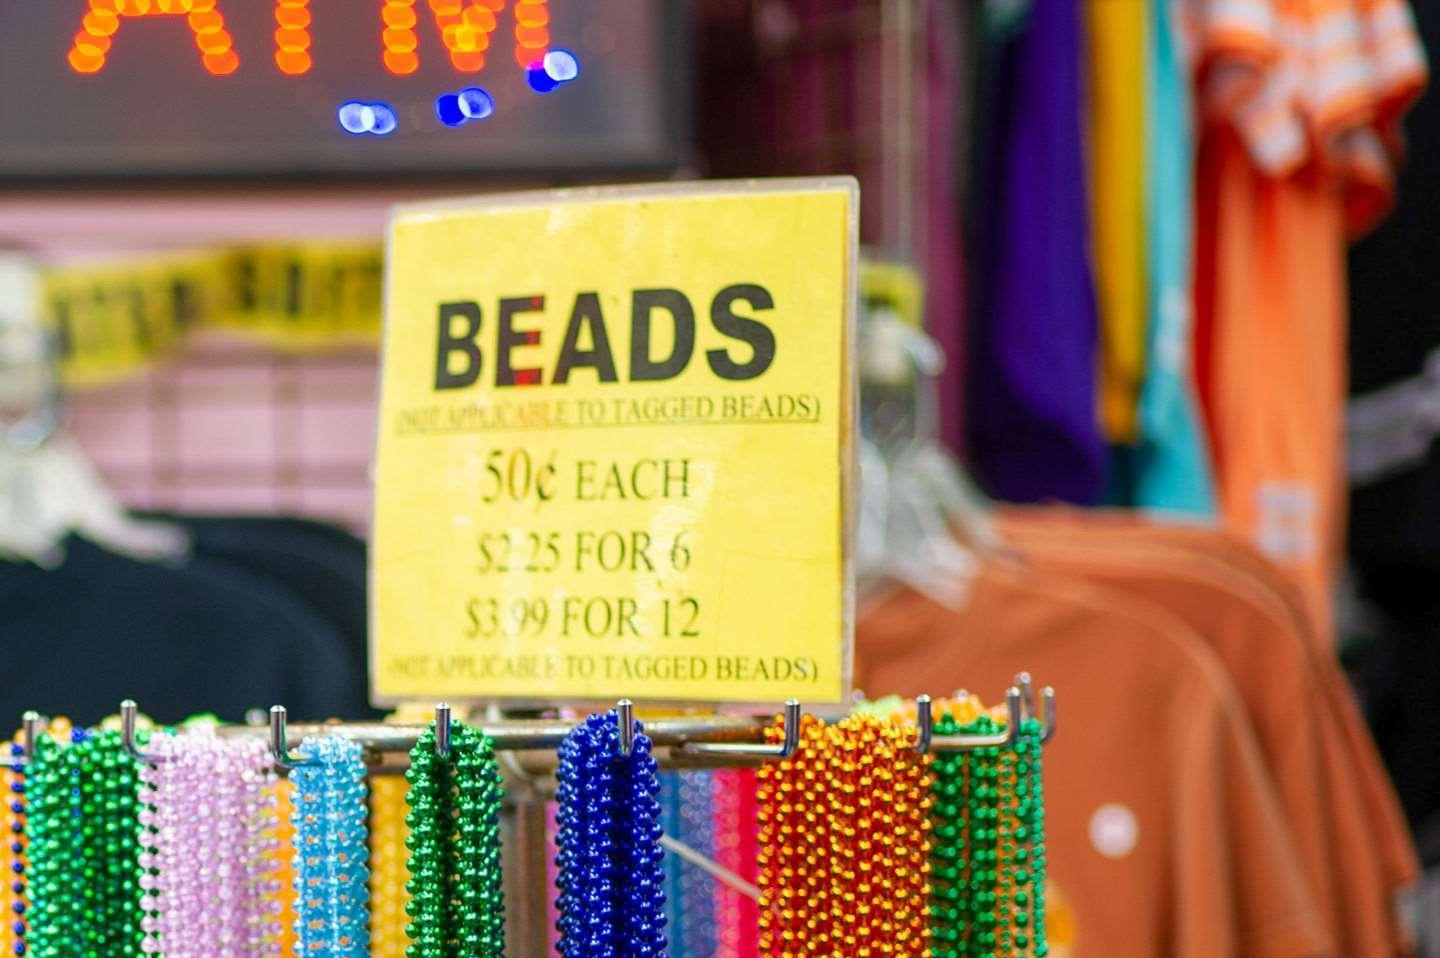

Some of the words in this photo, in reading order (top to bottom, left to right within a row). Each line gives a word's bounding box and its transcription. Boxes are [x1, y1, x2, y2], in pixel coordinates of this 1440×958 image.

[433, 283, 777, 391] BEADS
[576, 399, 607, 424] TO
[612, 397, 714, 423] TAGGED
[720, 394, 822, 423] BEADS)
[481, 447, 558, 513] 50¢
[575, 457, 692, 501] EACH
[477, 531, 562, 575] $225
[575, 530, 656, 573] FOR
[669, 529, 692, 572] 6
[561, 596, 641, 639] FOR
[660, 597, 701, 638] 12
[566, 655, 595, 681] TO
[603, 655, 708, 681] TAGGED
[716, 656, 819, 684] BEADS)
